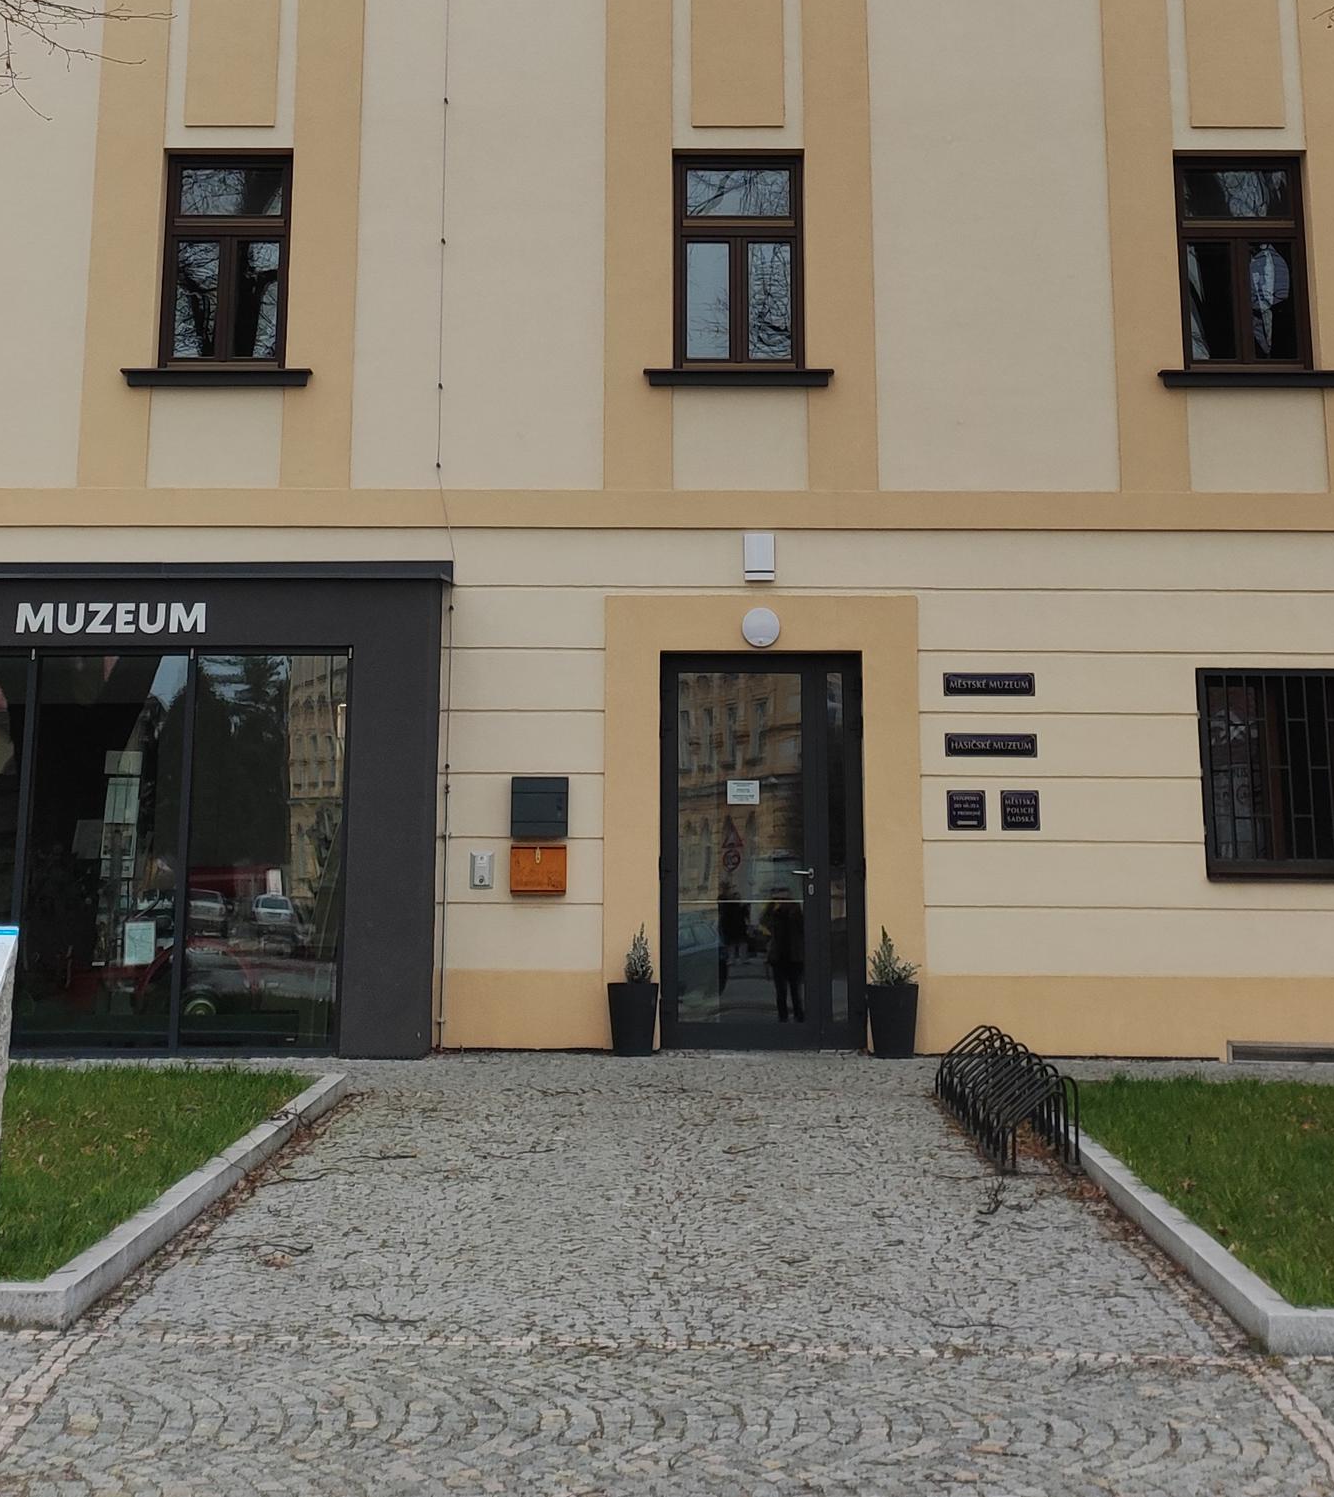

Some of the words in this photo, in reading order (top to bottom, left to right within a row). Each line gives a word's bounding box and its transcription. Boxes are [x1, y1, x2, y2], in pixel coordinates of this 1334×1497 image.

[15, 603, 207, 634] MUZEUM
[949, 679, 987, 689] MĚSTSKÉ
[988, 680, 1029, 689] MUZEUM
[951, 740, 990, 750] HASIČSKÉ
[993, 741, 1032, 750] MUZEUM
[1004, 797, 1036, 805] MĚSTSKÁ
[1006, 815, 1034, 823] SADSKÁ
